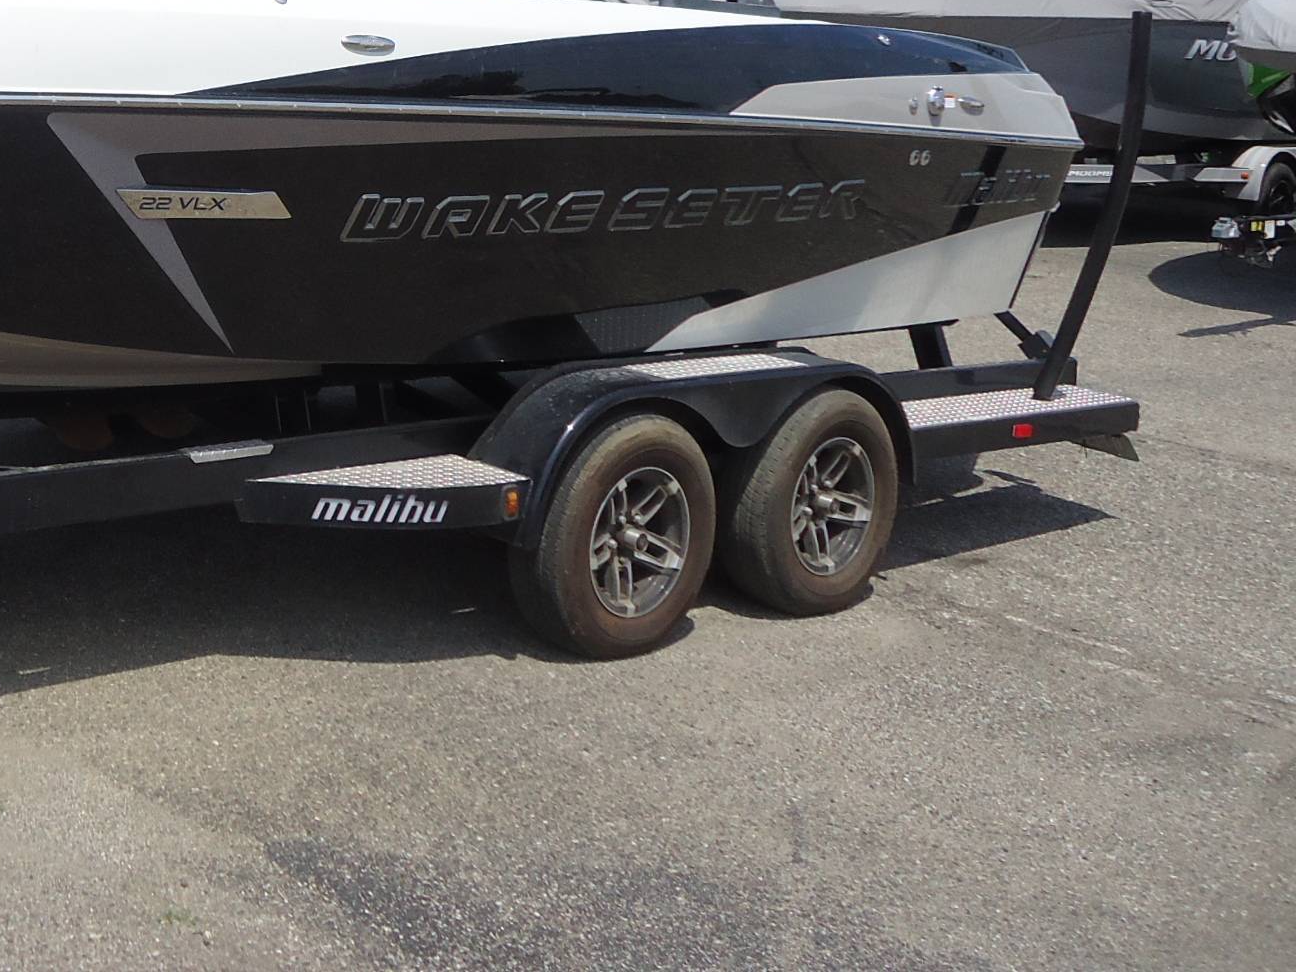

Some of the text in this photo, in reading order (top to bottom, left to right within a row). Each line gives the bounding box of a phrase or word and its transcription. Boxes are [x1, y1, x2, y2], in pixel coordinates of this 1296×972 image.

[138, 196, 228, 211] 22 VLX
[310, 494, 449, 524] malibu
